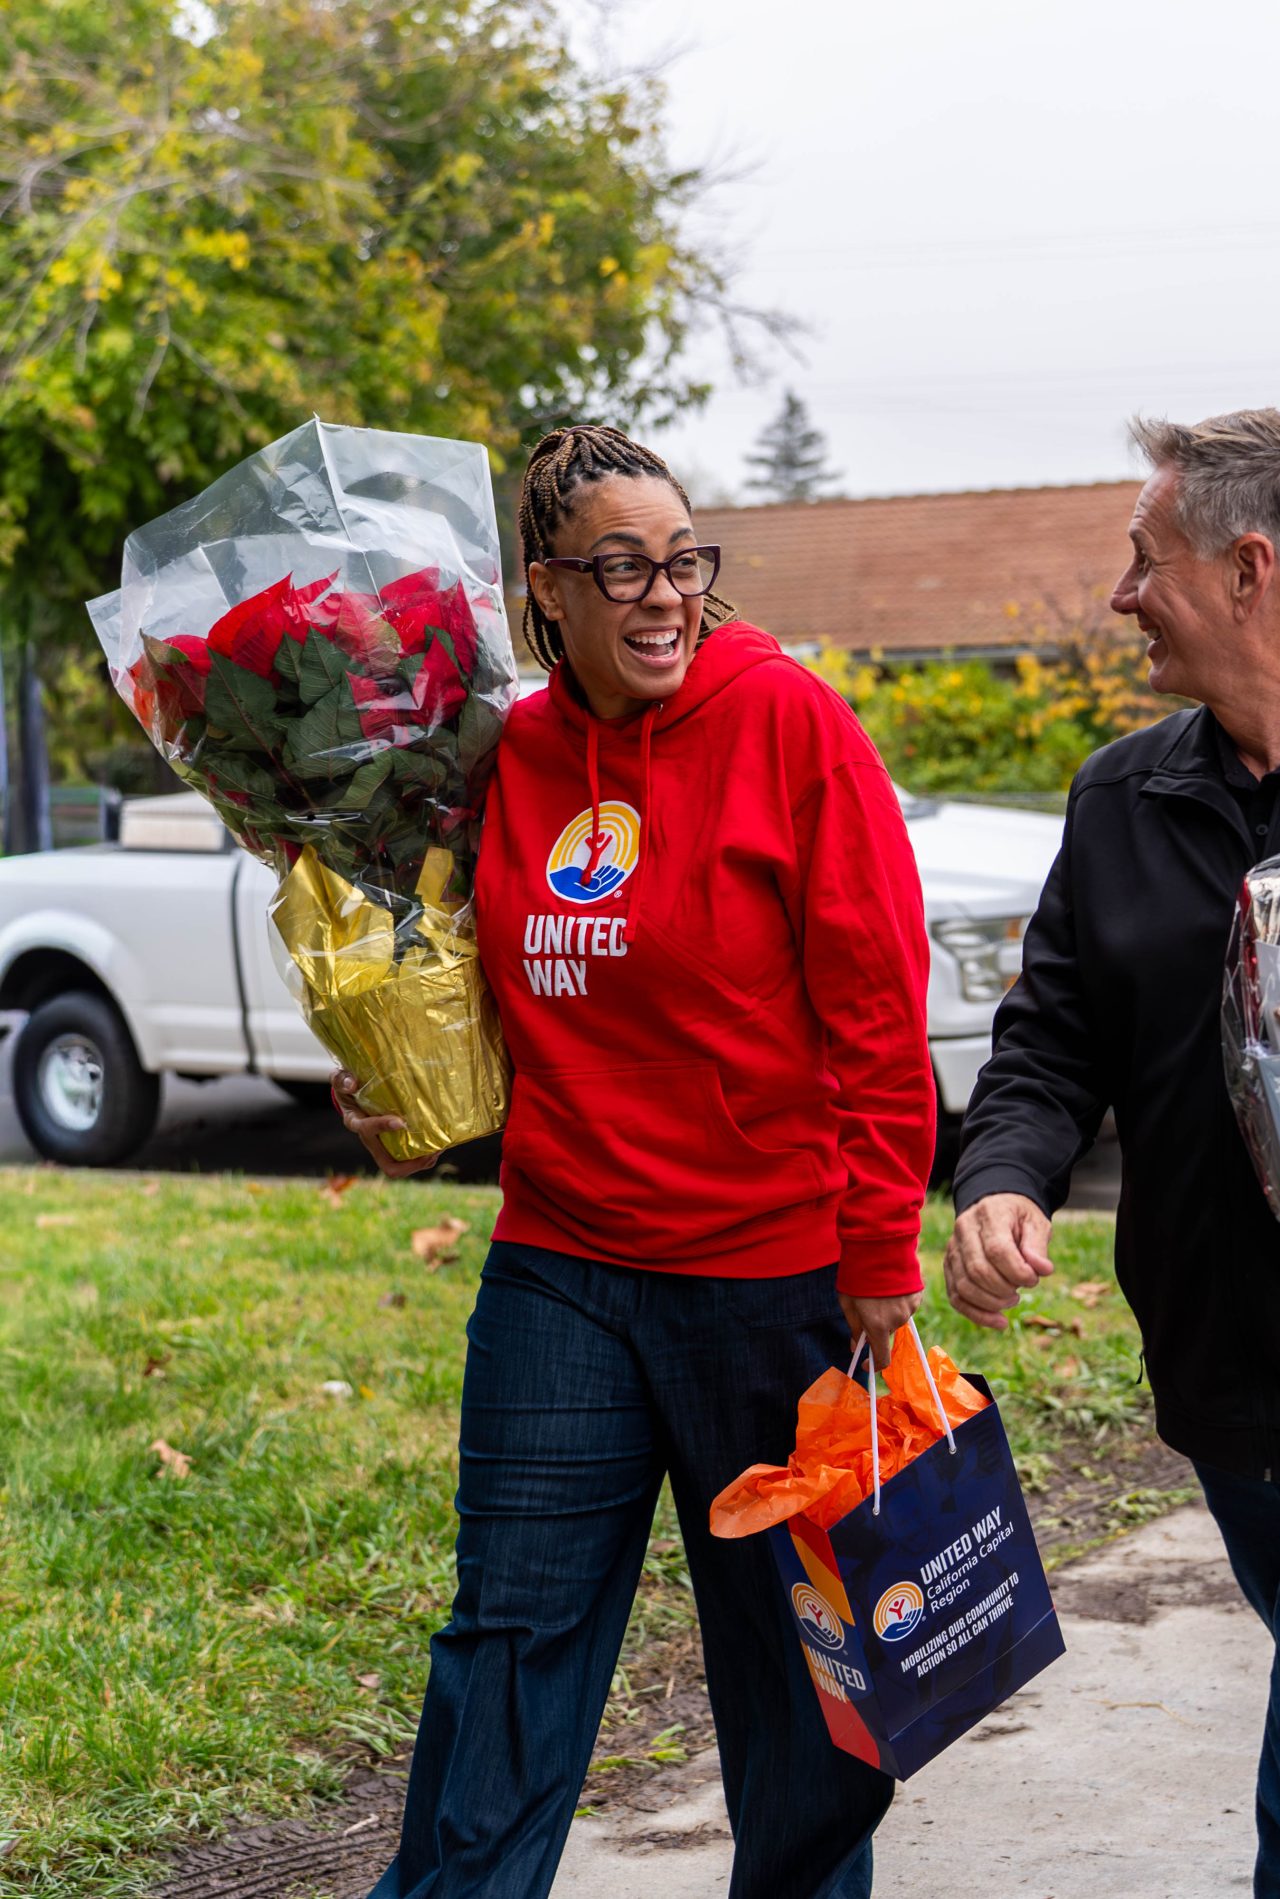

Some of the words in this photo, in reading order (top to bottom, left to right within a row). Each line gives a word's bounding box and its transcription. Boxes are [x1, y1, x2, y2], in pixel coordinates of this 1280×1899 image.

[524, 915, 629, 957] UNITED
[523, 959, 588, 997] WAY
[920, 1533, 972, 1585] UNITED
[972, 1505, 1001, 1544] WAY
[927, 1555, 978, 1599] California
[980, 1521, 1014, 1558] Capital
[930, 1578, 970, 1613] Region
[900, 1631, 948, 1673] MOBILIZING
[948, 1617, 966, 1637] OUR
[965, 1580, 1009, 1625] COMMUNITY
[1008, 1572, 1019, 1588] TO
[916, 1648, 947, 1678] ACTION
[946, 1643, 958, 1655] SO
[959, 1630, 973, 1647] ALL
[972, 1617, 989, 1636] CAN
[988, 1594, 1014, 1623] THRIVE
[807, 1645, 866, 1691] UNITED
[815, 1668, 847, 1704] WAY
